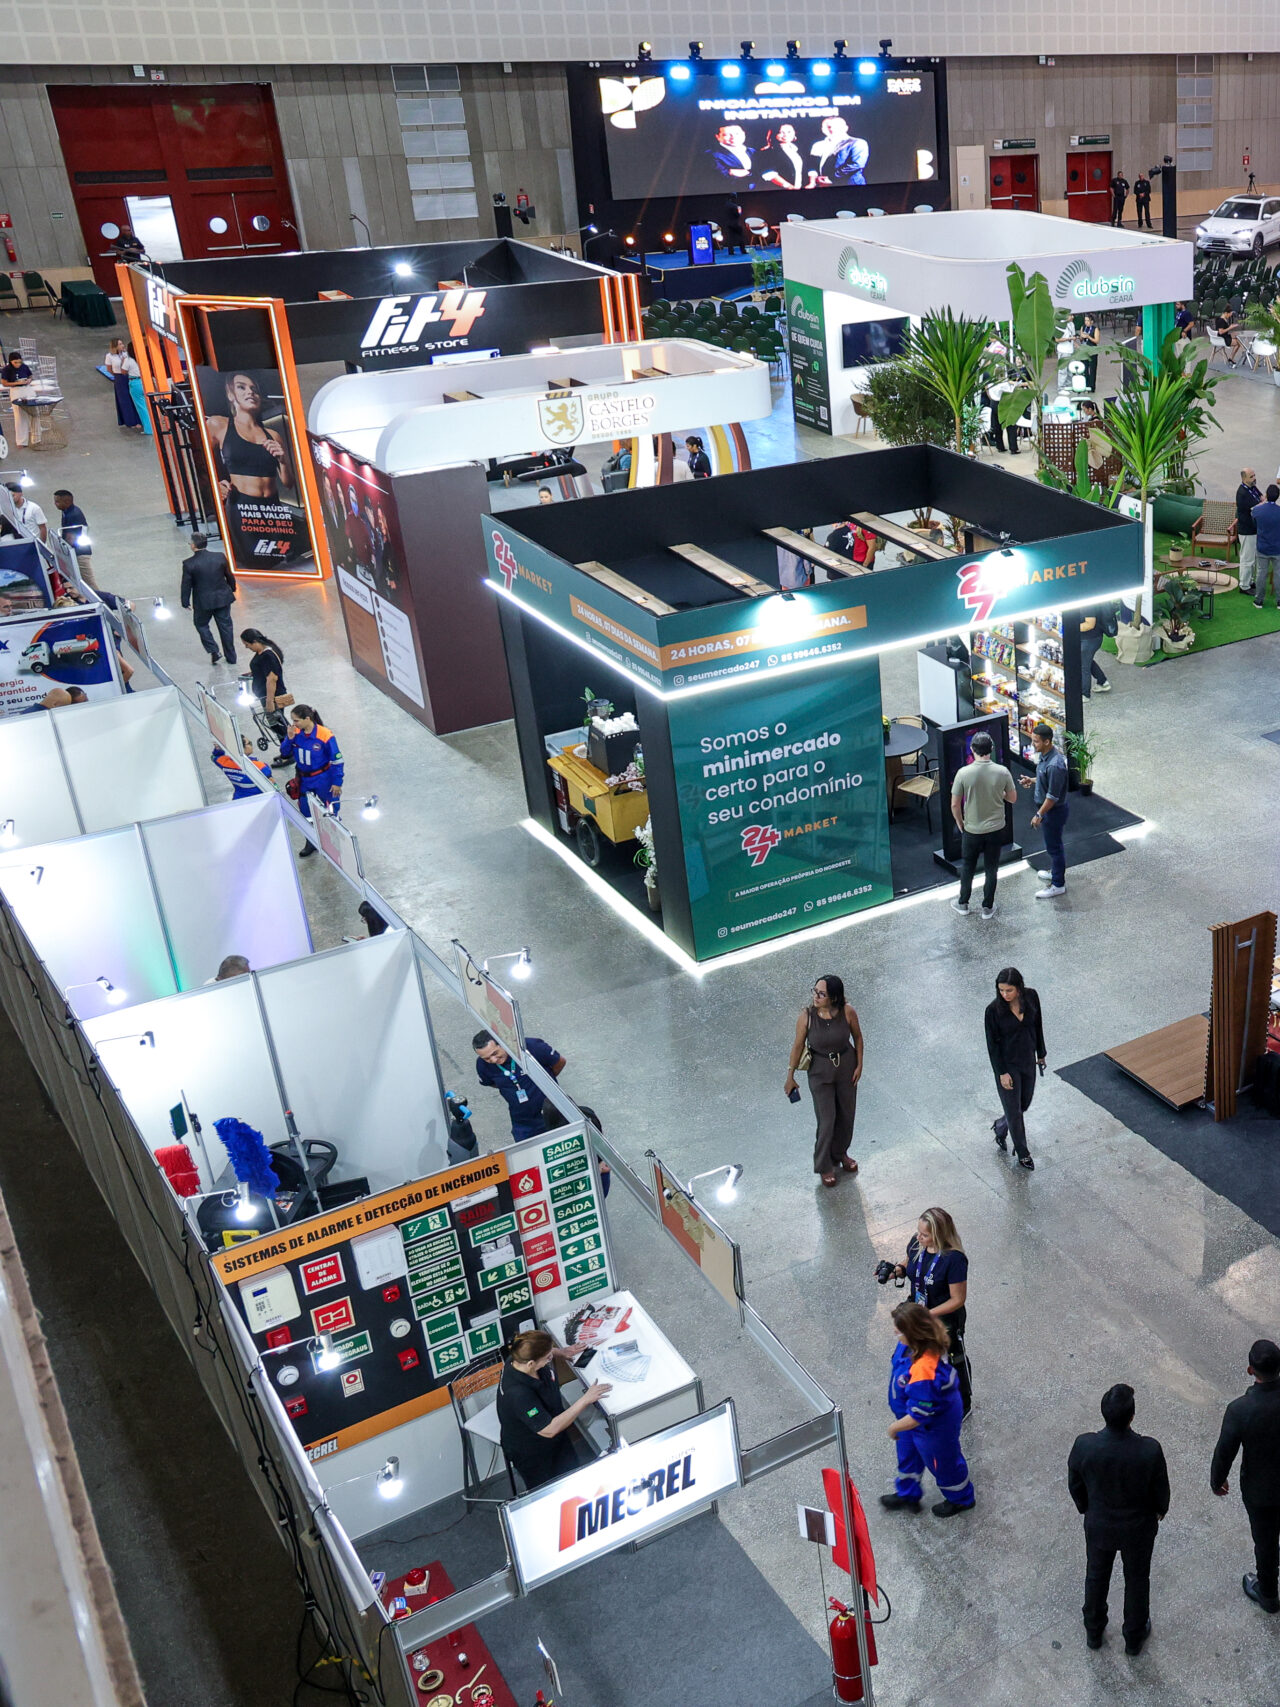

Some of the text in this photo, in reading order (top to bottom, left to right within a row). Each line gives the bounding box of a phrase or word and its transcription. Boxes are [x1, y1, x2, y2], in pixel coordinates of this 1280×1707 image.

[699, 95, 861, 110] INICIAREMOS EM
[1076, 277, 1134, 299] clubsin
[1109, 293, 1134, 304] CEARÁ
[361, 338, 469, 358] FITNESS STORE
[587, 391, 619, 402] GRUPO
[589, 396, 655, 416] CASTELO
[590, 412, 649, 431] BORGES
[237, 502, 293, 513] MAIS SAÚDE,
[240, 511, 292, 520] MAIS VALOR
[241, 518, 267, 526] PARA
[518, 563, 553, 595] MARKET
[670, 648, 686, 660] 24
[688, 639, 735, 657] HORAS,
[736, 636, 750, 647] 07
[781, 653, 793, 662] 85
[687, 659, 760, 683] seumercado247
[0, 678, 24, 689] ergia
[0, 685, 37, 698] arantida
[7, 692, 47, 705] seu cond
[700, 722, 787, 754] Somos o
[703, 731, 842, 778] minimercado
[705, 760, 826, 801] certo para o
[708, 772, 863, 825] seu condomínio
[741, 816, 839, 852] 24 MARKET
[747, 842, 772, 867] 7
[740, 886, 760, 897] MAIOR
[760, 876, 791, 892] OPERAÇÃO
[791, 868, 815, 882] PRÓPRIA
[824, 859, 851, 873] NORDESTE
[816, 884, 873, 907] 85 99646.6352
[730, 907, 797, 933] seumercado247
[546, 1138, 581, 1157] SAÍDA
[566, 1158, 585, 1169] SAÍDA
[553, 1184, 572, 1195] SAÍDA
[223, 1163, 500, 1273] SISTEMAS DE ALARME E DETECÇÃO DE INCÊNDIOS
[460, 1201, 495, 1224] SAÍDA
[557, 1200, 592, 1219] SAÍDA
[580, 1217, 598, 1229] SAÍDA
[307, 1260, 335, 1274] CENTRAL
[311, 1274, 338, 1287] ALARME
[417, 1302, 432, 1310] SAÍDA
[500, 1286, 529, 1309] 2ºSS
[428, 1321, 457, 1335] COBERTURA
[475, 1326, 490, 1344] T
[476, 1340, 497, 1351] TÉRREO
[438, 1347, 460, 1364] SS
[438, 1359, 464, 1373] SUBSOLO
